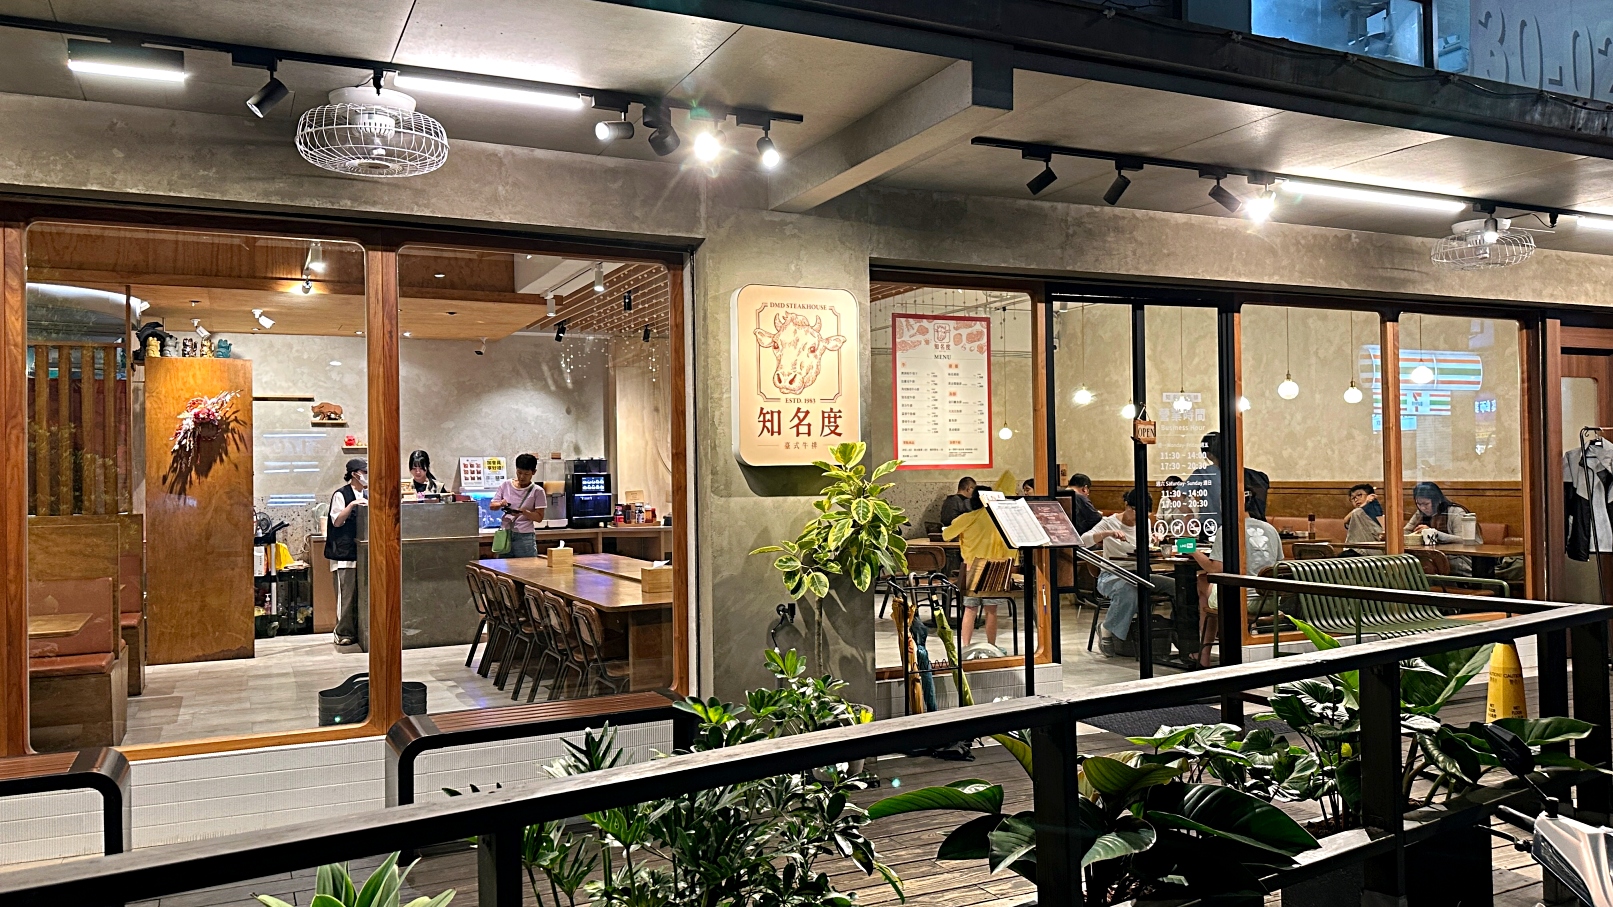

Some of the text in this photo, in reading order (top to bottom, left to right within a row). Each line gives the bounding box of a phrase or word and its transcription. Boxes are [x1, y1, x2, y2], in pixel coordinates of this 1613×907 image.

[769, 301, 827, 311] DMD STEAKHOUSE
[757, 406, 843, 438] 知名度
[1137, 427, 1156, 438] OPEN
[1160, 451, 1180, 460] 11:30
[1187, 451, 1207, 460] 14:00
[1160, 462, 1180, 470] 17:30
[1187, 461, 1207, 470] 20:30
[1161, 489, 1181, 498] 11:30
[1188, 489, 1208, 497] 14:00
[1161, 499, 1182, 508] 17:00
[1188, 499, 1209, 508] 20:30
